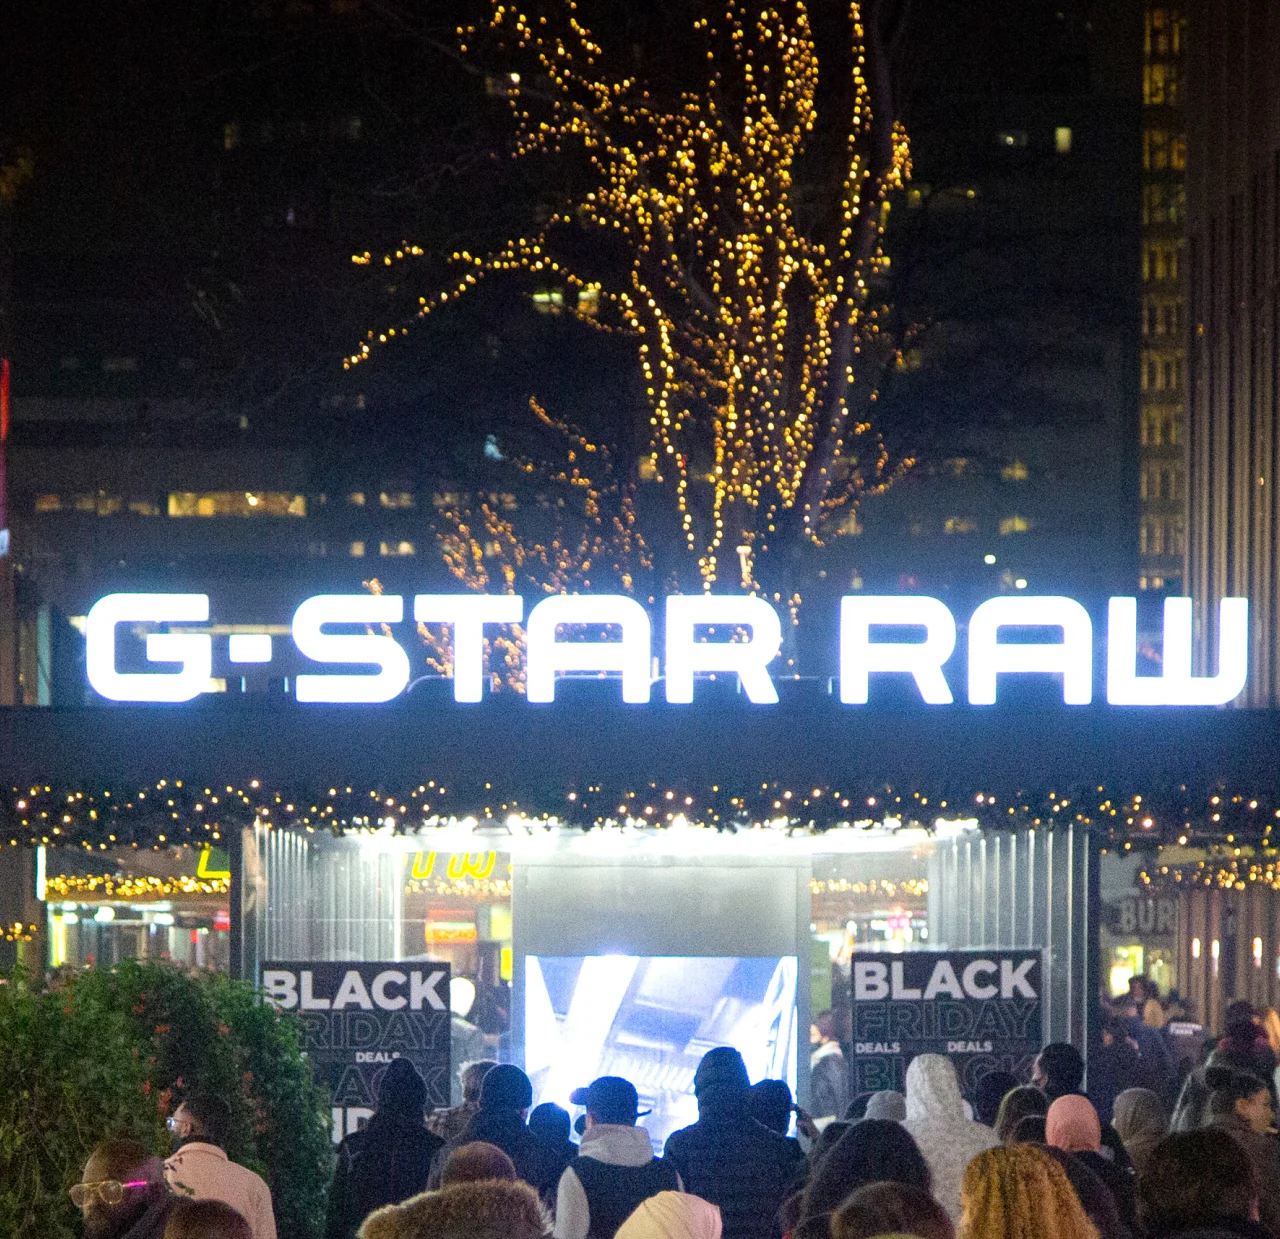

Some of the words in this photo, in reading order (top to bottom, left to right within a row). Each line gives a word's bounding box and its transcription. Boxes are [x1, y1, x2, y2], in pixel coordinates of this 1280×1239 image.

[85, 591, 782, 704] G-STAR
[839, 595, 1249, 706] RAW
[263, 970, 447, 1010] BLACK
[854, 959, 1038, 1000] BLACK
[301, 1011, 447, 1050] RIDAY
[854, 1001, 1038, 1039] FRIDAY
[854, 1042, 901, 1054] DEALS
[947, 1040, 993, 1053] DEALS
